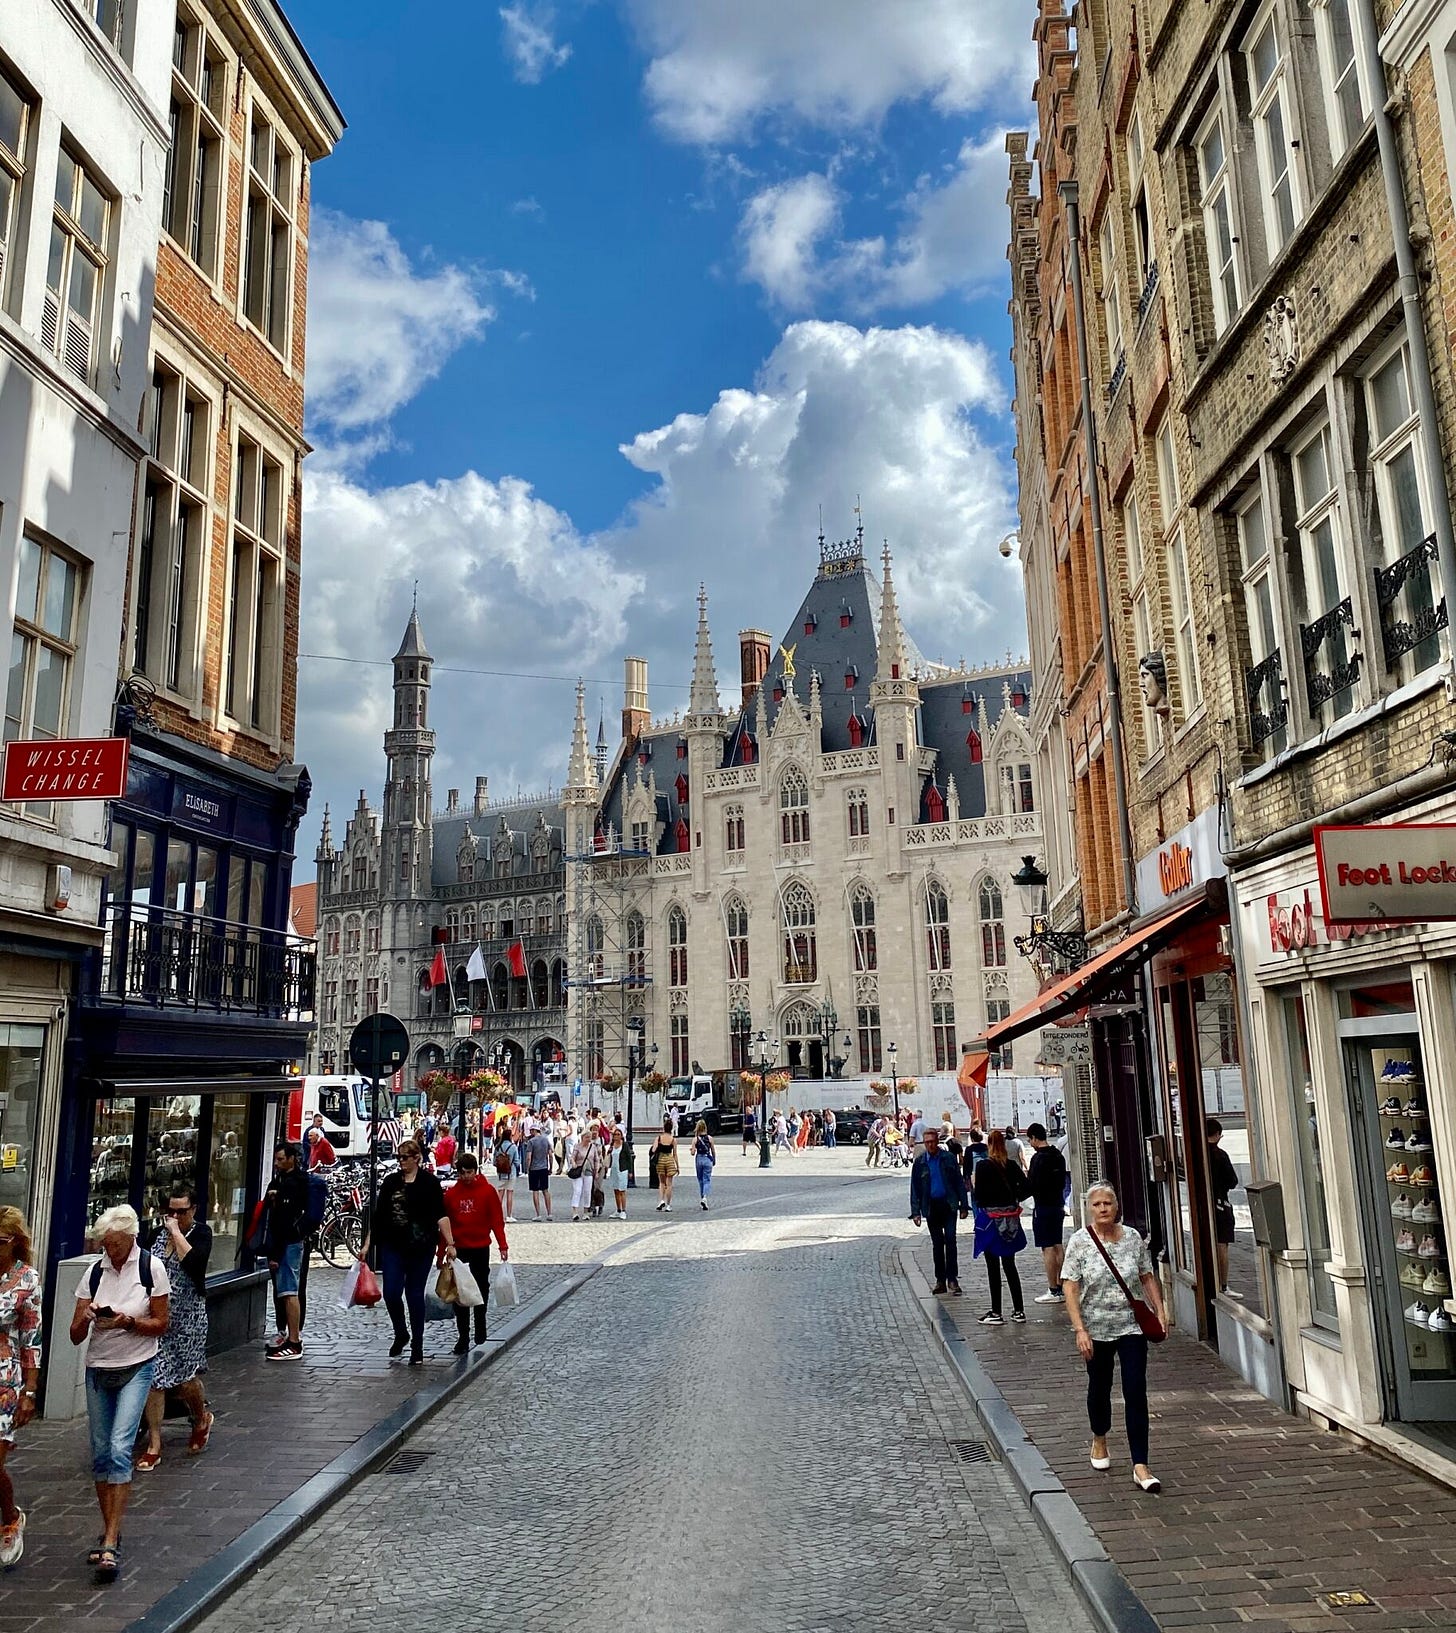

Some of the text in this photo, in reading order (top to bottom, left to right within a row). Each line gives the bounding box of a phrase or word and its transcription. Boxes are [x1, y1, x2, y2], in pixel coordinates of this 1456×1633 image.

[27, 749, 103, 767] WISSEL
[22, 773, 104, 791] CHANGE
[1337, 863, 1392, 886] Foot
